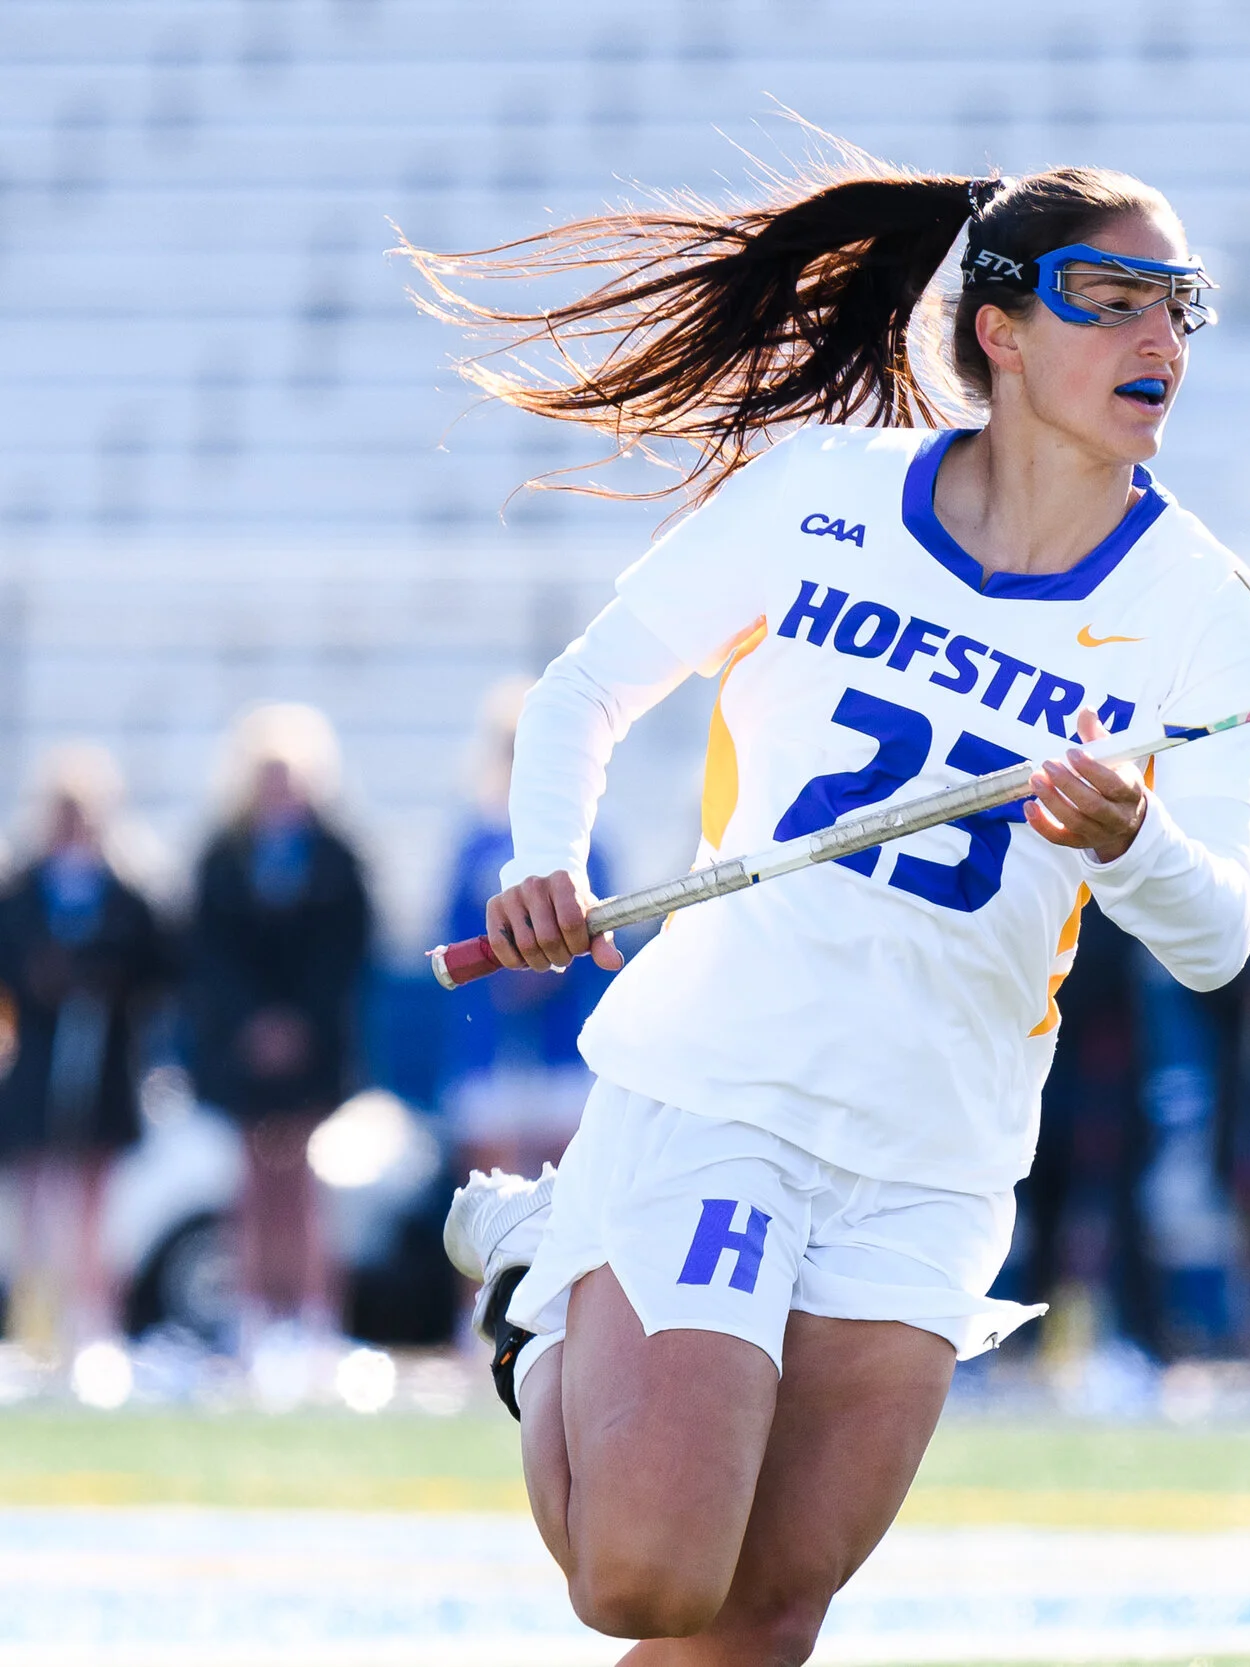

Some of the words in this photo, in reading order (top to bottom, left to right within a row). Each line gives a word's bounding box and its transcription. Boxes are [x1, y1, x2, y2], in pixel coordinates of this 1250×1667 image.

[974, 249, 1024, 280] STX
[800, 513, 866, 548] CAA
[777, 580, 1135, 745] HOFSTRA
[773, 687, 1041, 913] 23
[676, 1199, 772, 1294] H
